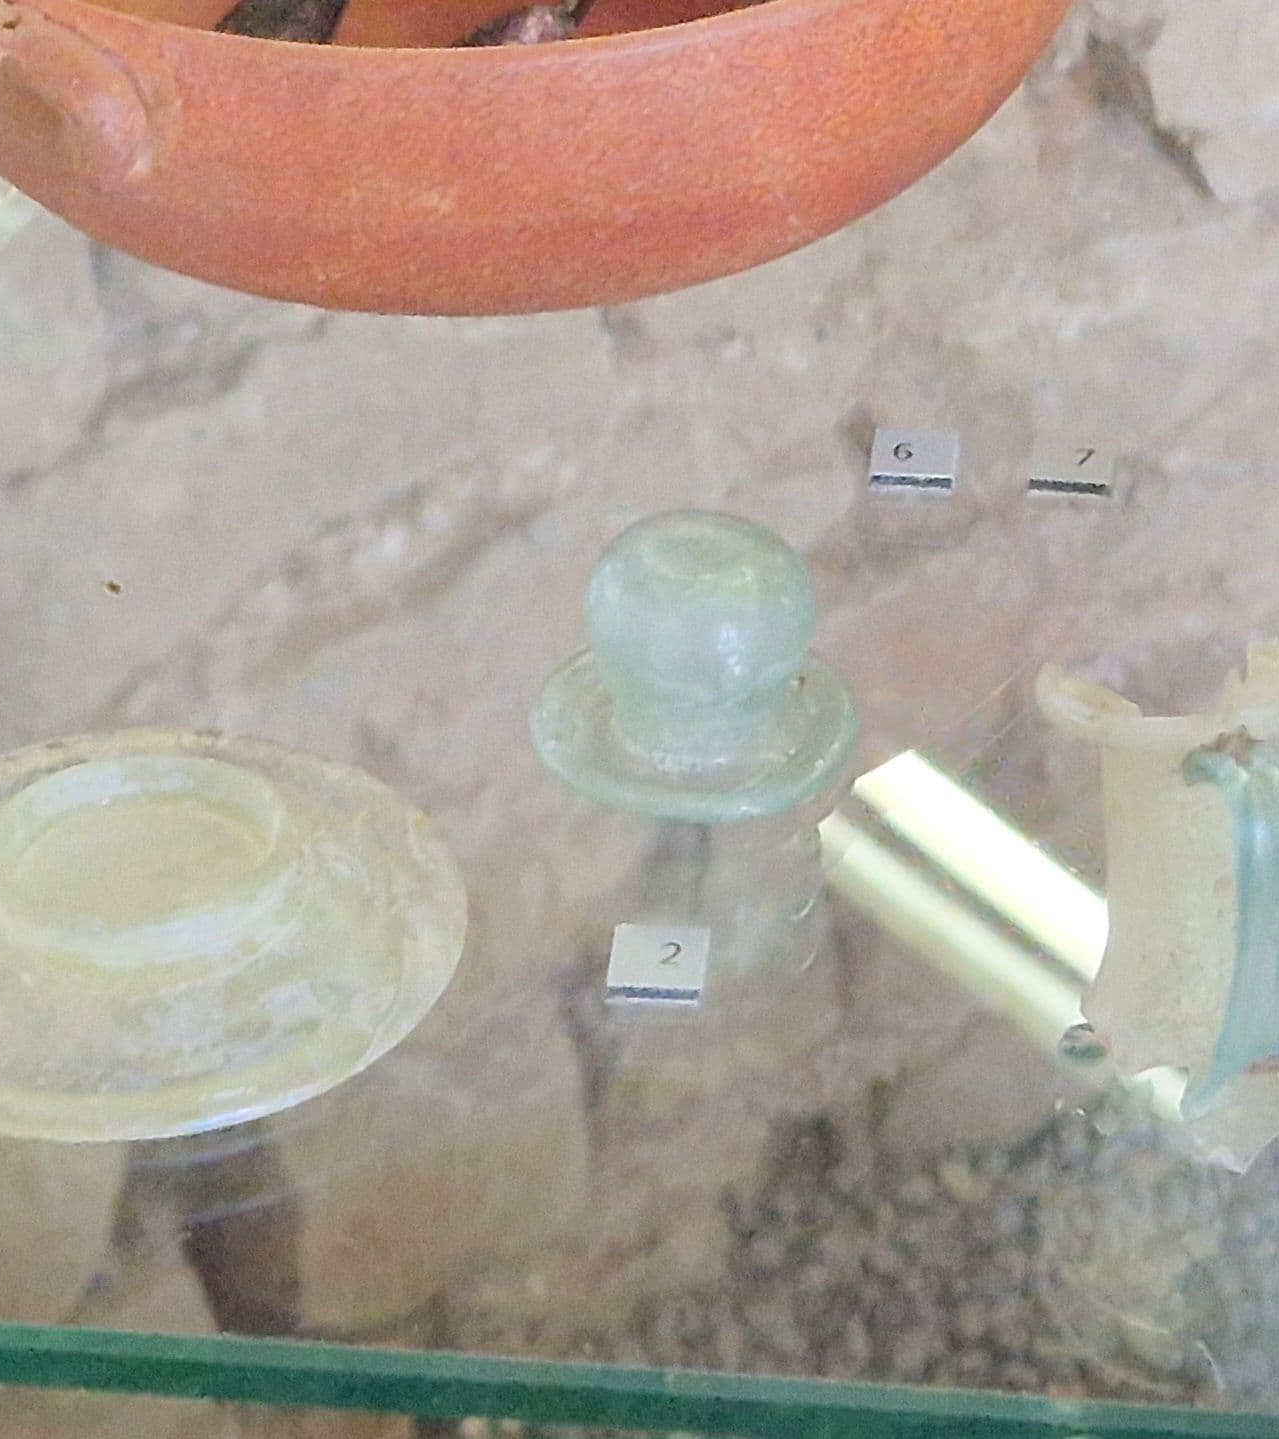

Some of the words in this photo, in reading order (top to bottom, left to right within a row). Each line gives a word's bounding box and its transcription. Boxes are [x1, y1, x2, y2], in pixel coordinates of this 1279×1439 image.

[893, 442, 914, 462] 6
[1075, 448, 1096, 467] 7
[657, 940, 683, 968] 2
